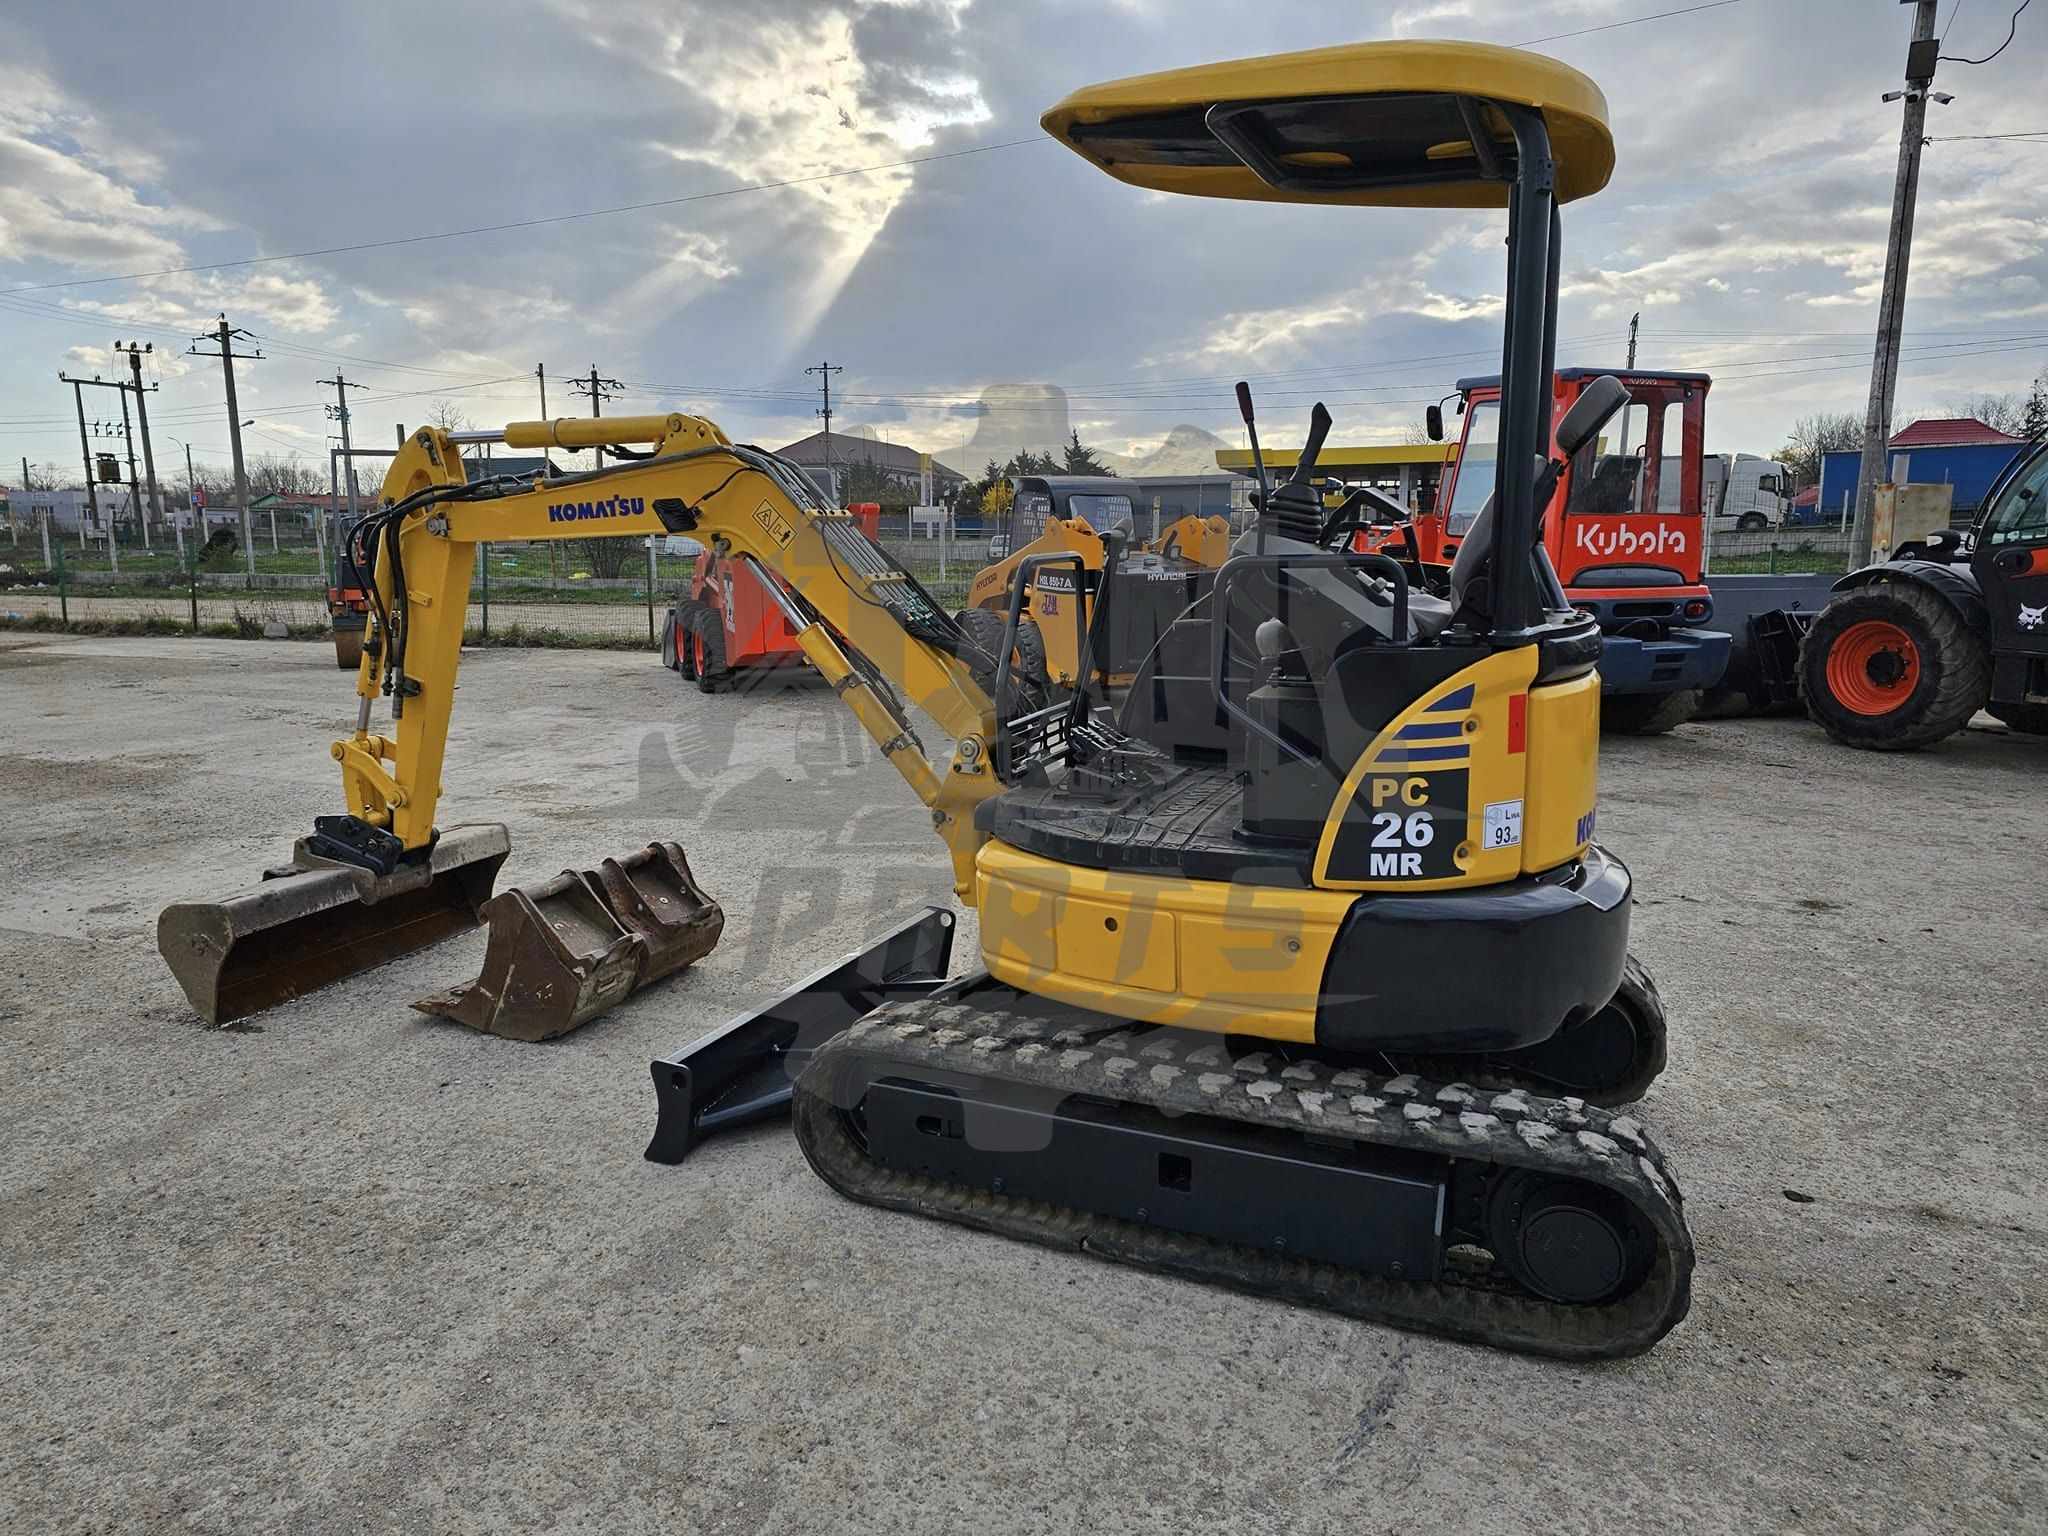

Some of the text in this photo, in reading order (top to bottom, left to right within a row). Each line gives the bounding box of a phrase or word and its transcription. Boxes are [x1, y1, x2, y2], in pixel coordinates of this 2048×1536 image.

[548, 494, 645, 522] KOMATSU
[1576, 523, 1686, 556] Kubota
[1372, 777, 1430, 808] PC
[1371, 811, 1434, 848] 26
[1495, 825, 1511, 845] 93
[1370, 853, 1424, 877] MR
